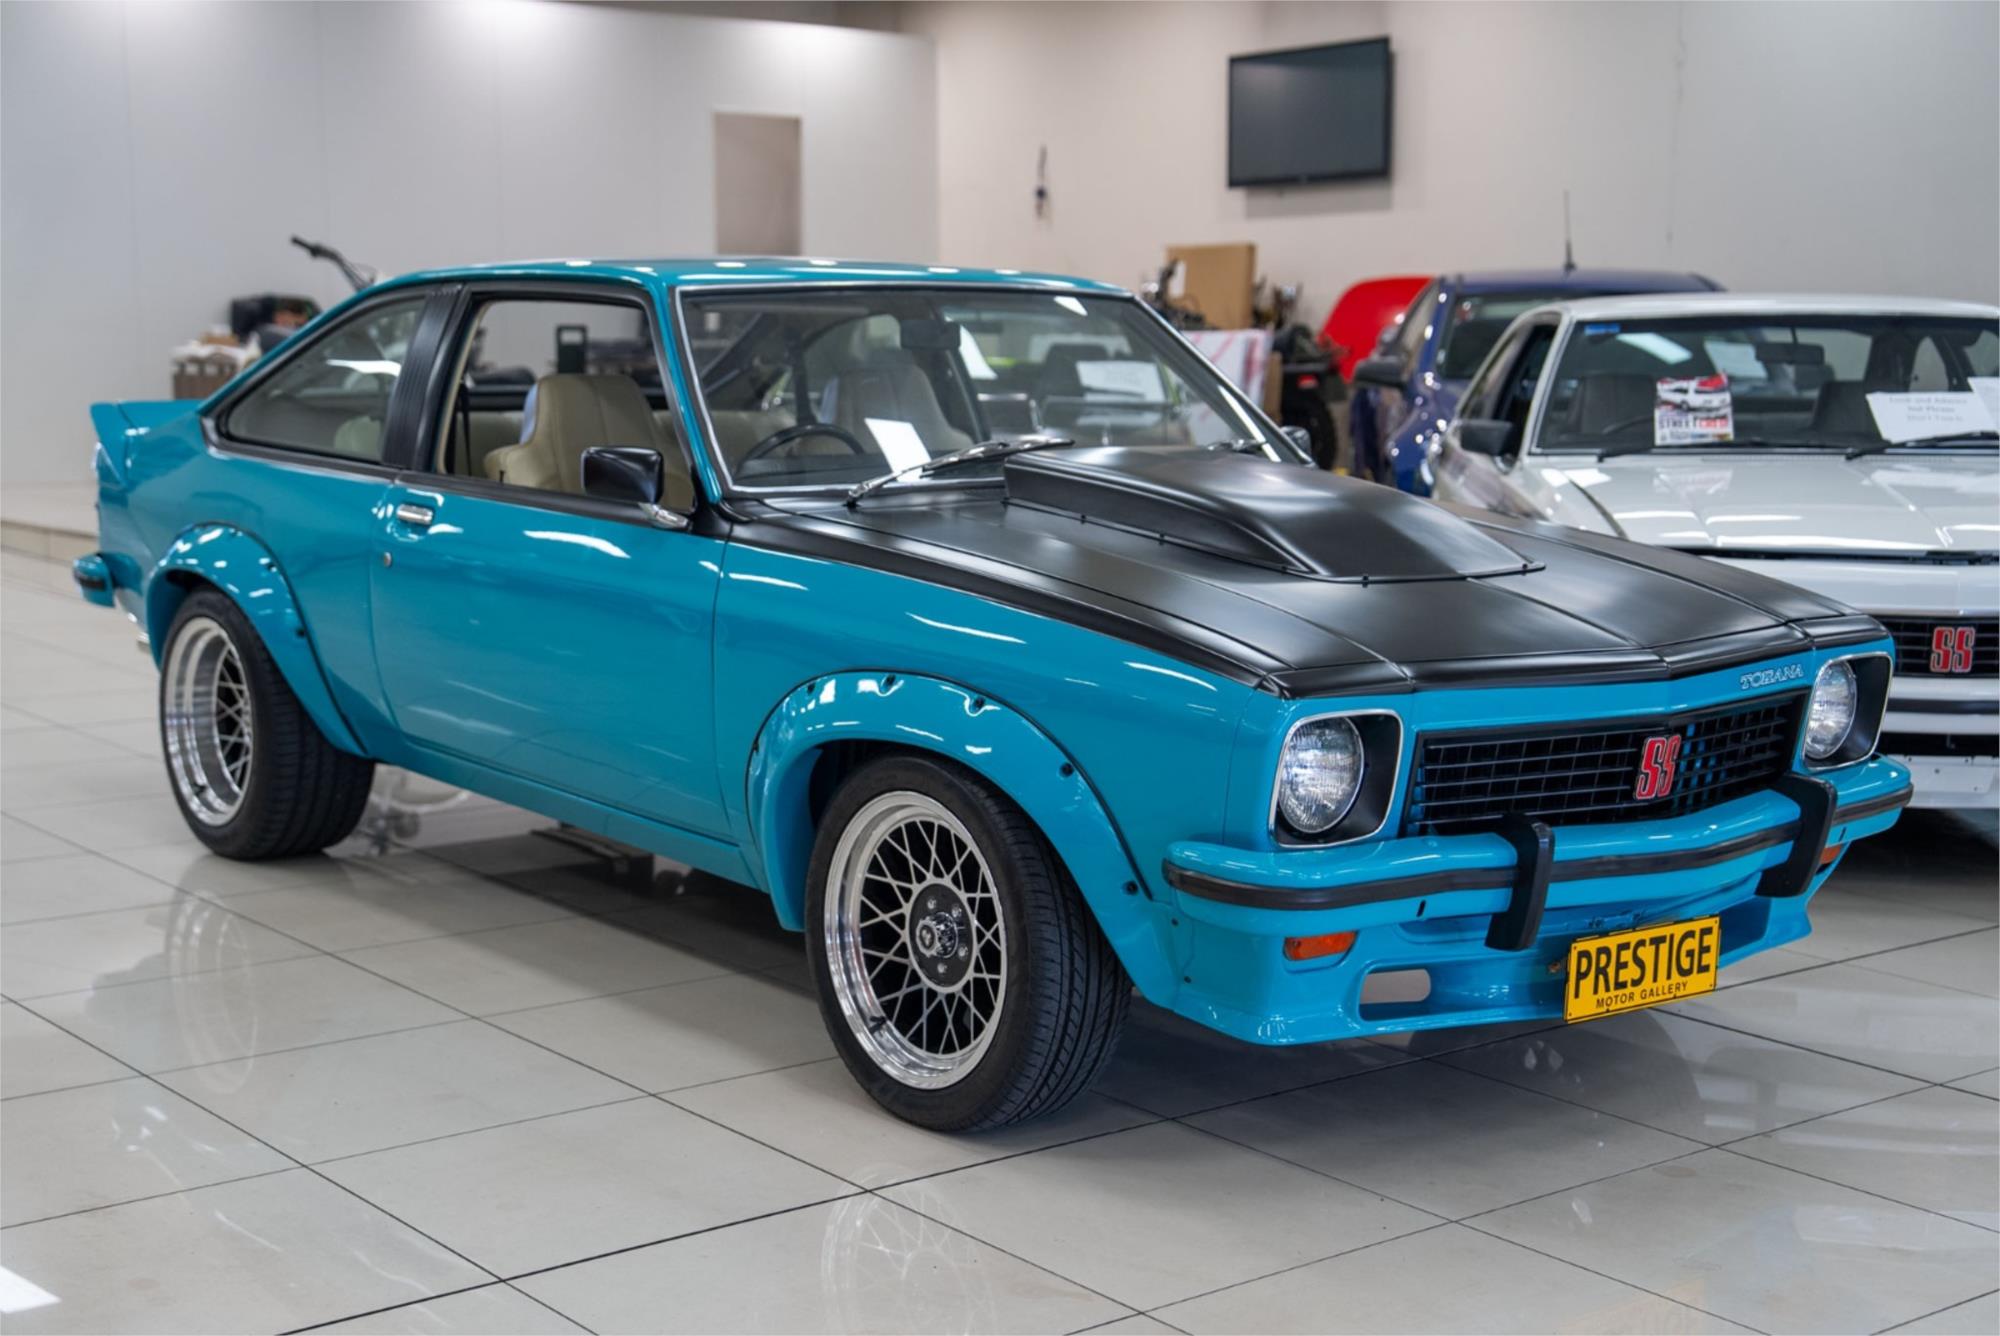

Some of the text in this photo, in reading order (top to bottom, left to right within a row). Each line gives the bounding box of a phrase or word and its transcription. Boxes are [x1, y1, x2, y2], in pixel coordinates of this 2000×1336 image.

[1930, 626, 1975, 673] SS
[1740, 663, 1804, 690] TORANA
[1635, 733, 1681, 800] SS
[1574, 926, 1713, 999] PRESTIGE
[1596, 981, 1688, 1009] MOTOR GALLERY
